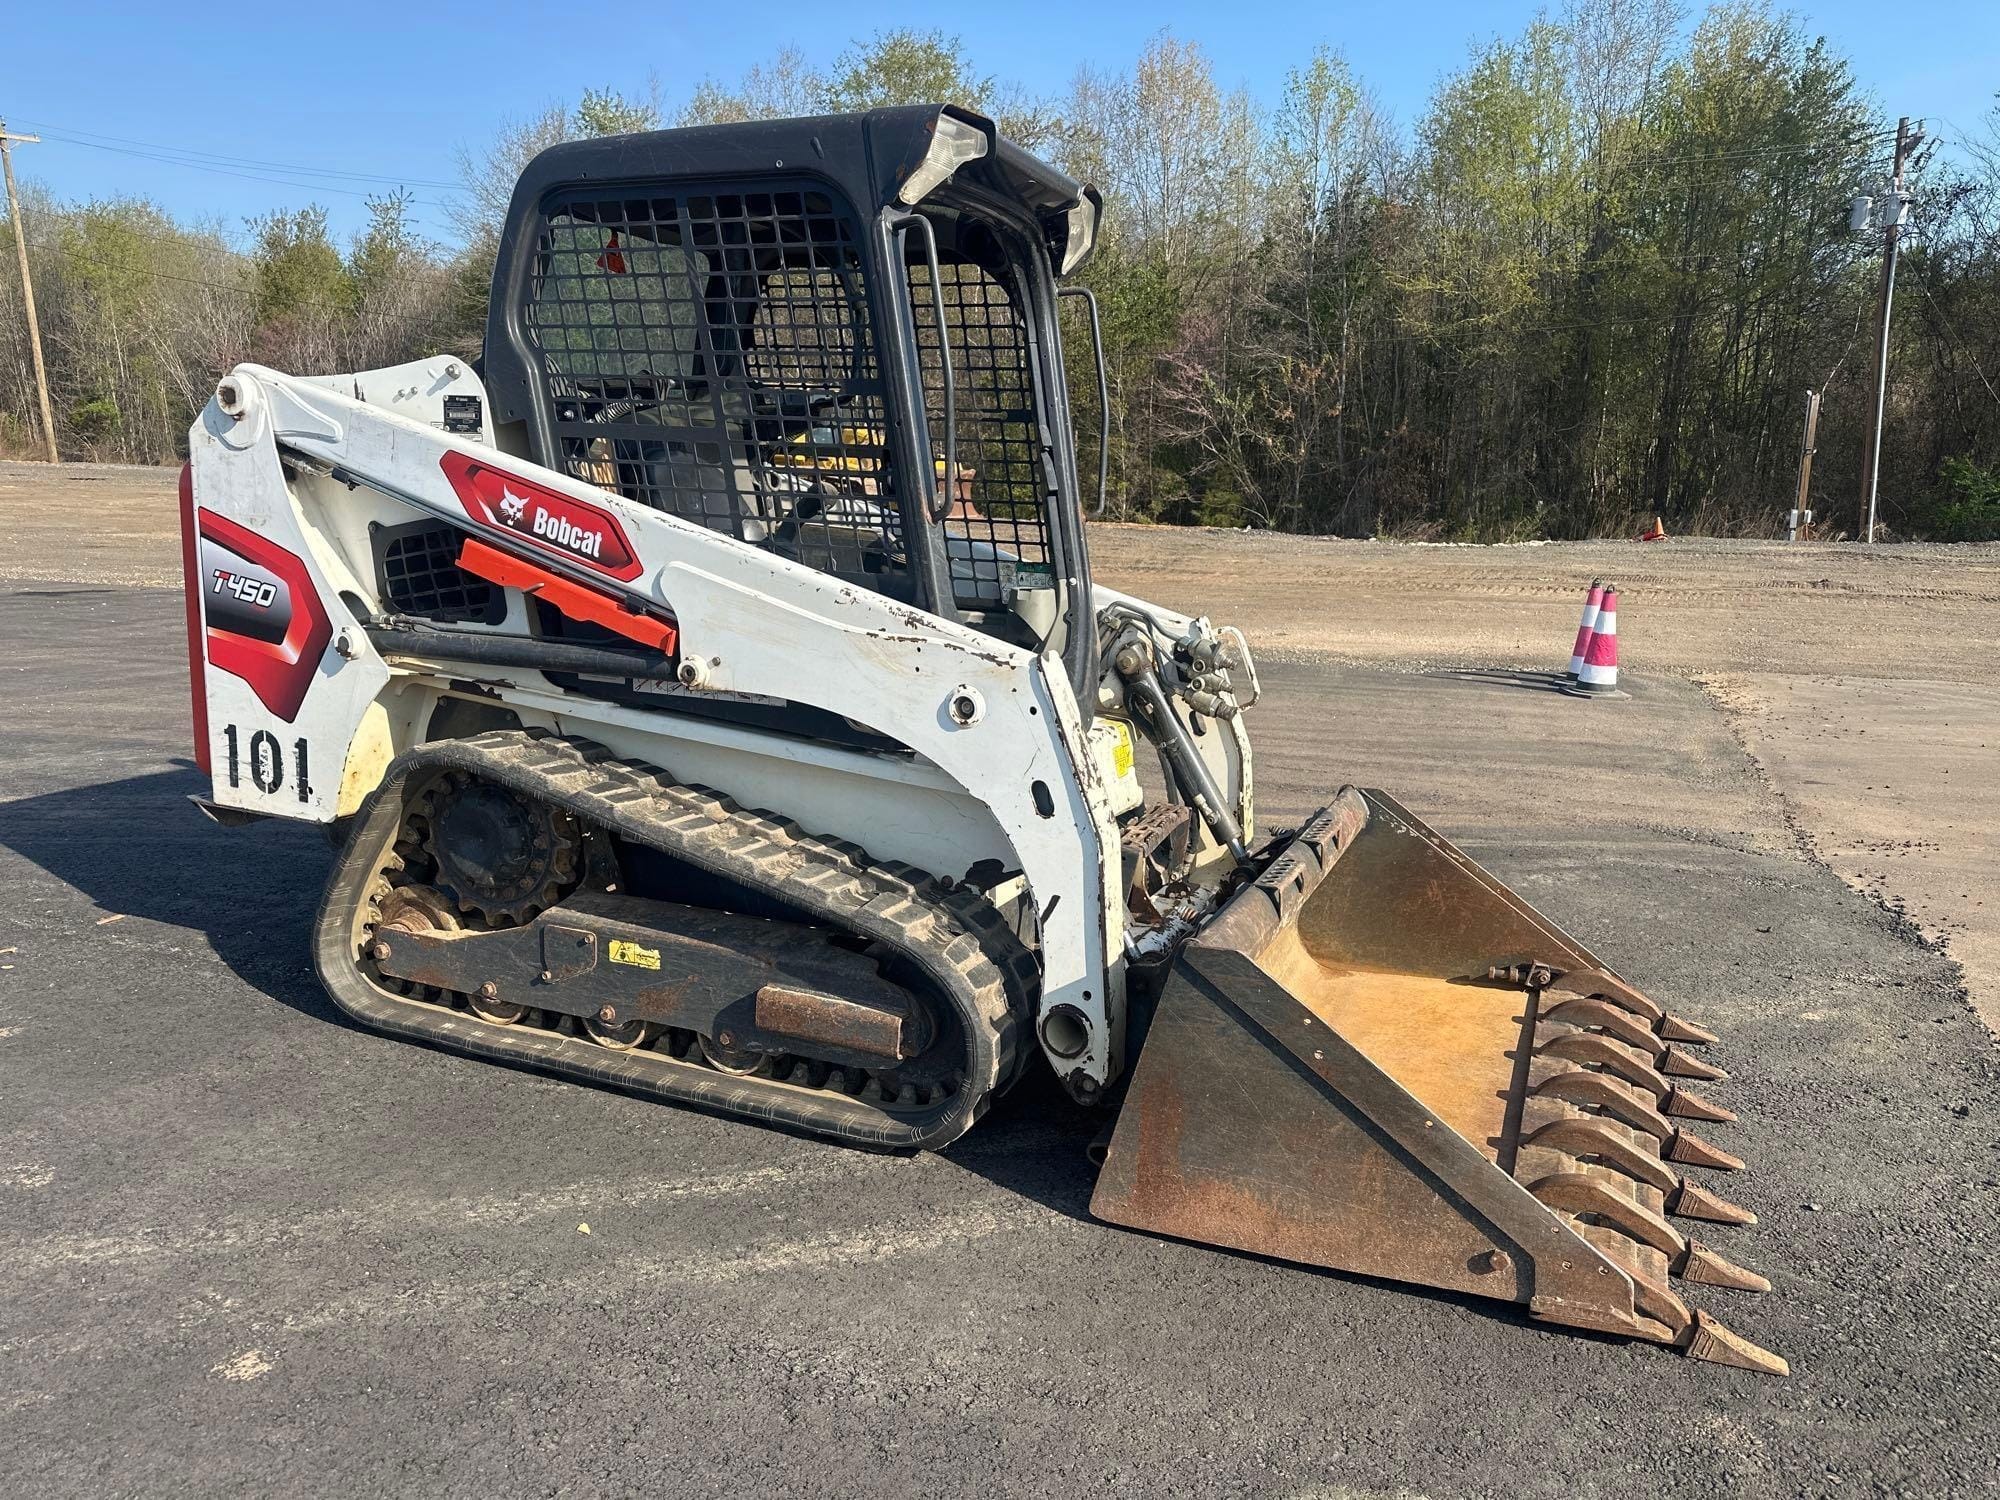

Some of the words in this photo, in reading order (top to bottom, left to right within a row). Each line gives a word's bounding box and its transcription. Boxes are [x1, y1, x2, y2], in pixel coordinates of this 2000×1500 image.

[533, 506, 602, 558] Bobcat
[213, 569, 277, 608] T450
[224, 723, 308, 803] 101
